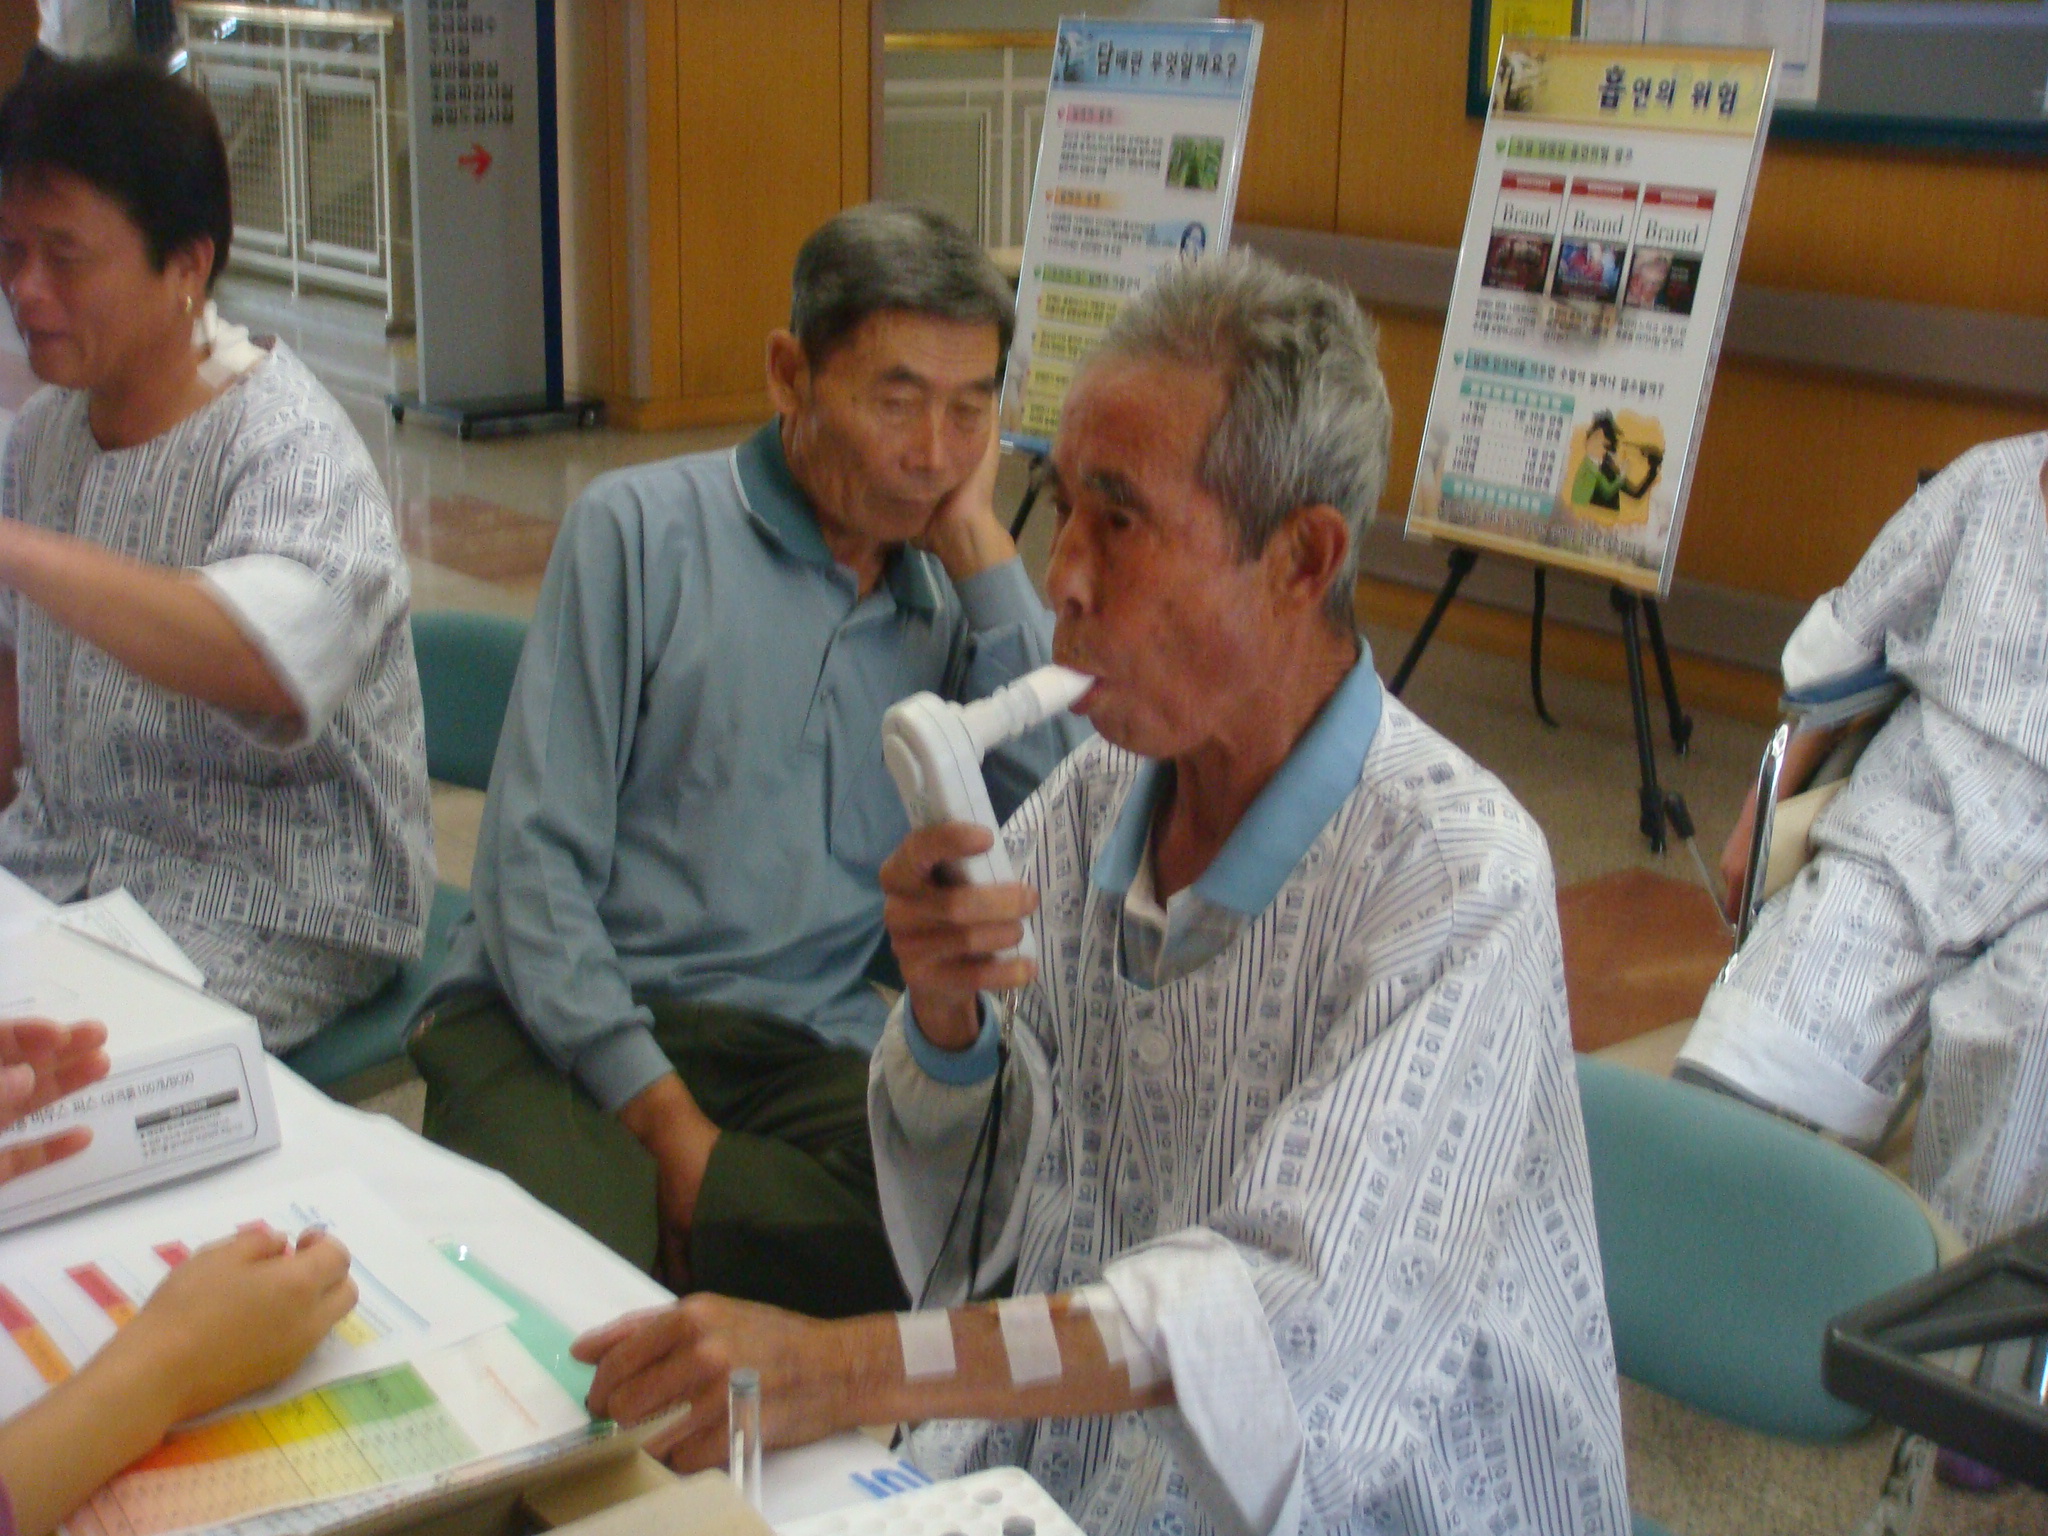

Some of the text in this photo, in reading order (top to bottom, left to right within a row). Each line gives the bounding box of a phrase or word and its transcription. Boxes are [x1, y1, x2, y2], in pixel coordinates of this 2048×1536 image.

[1097, 39, 1237, 80] 담배란 무엇일까요?
[1599, 63, 1739, 118] 흡연의 위험
[1503, 202, 1551, 229] Brand
[1573, 209, 1625, 236] Brand
[1645, 218, 1699, 245] Brand
